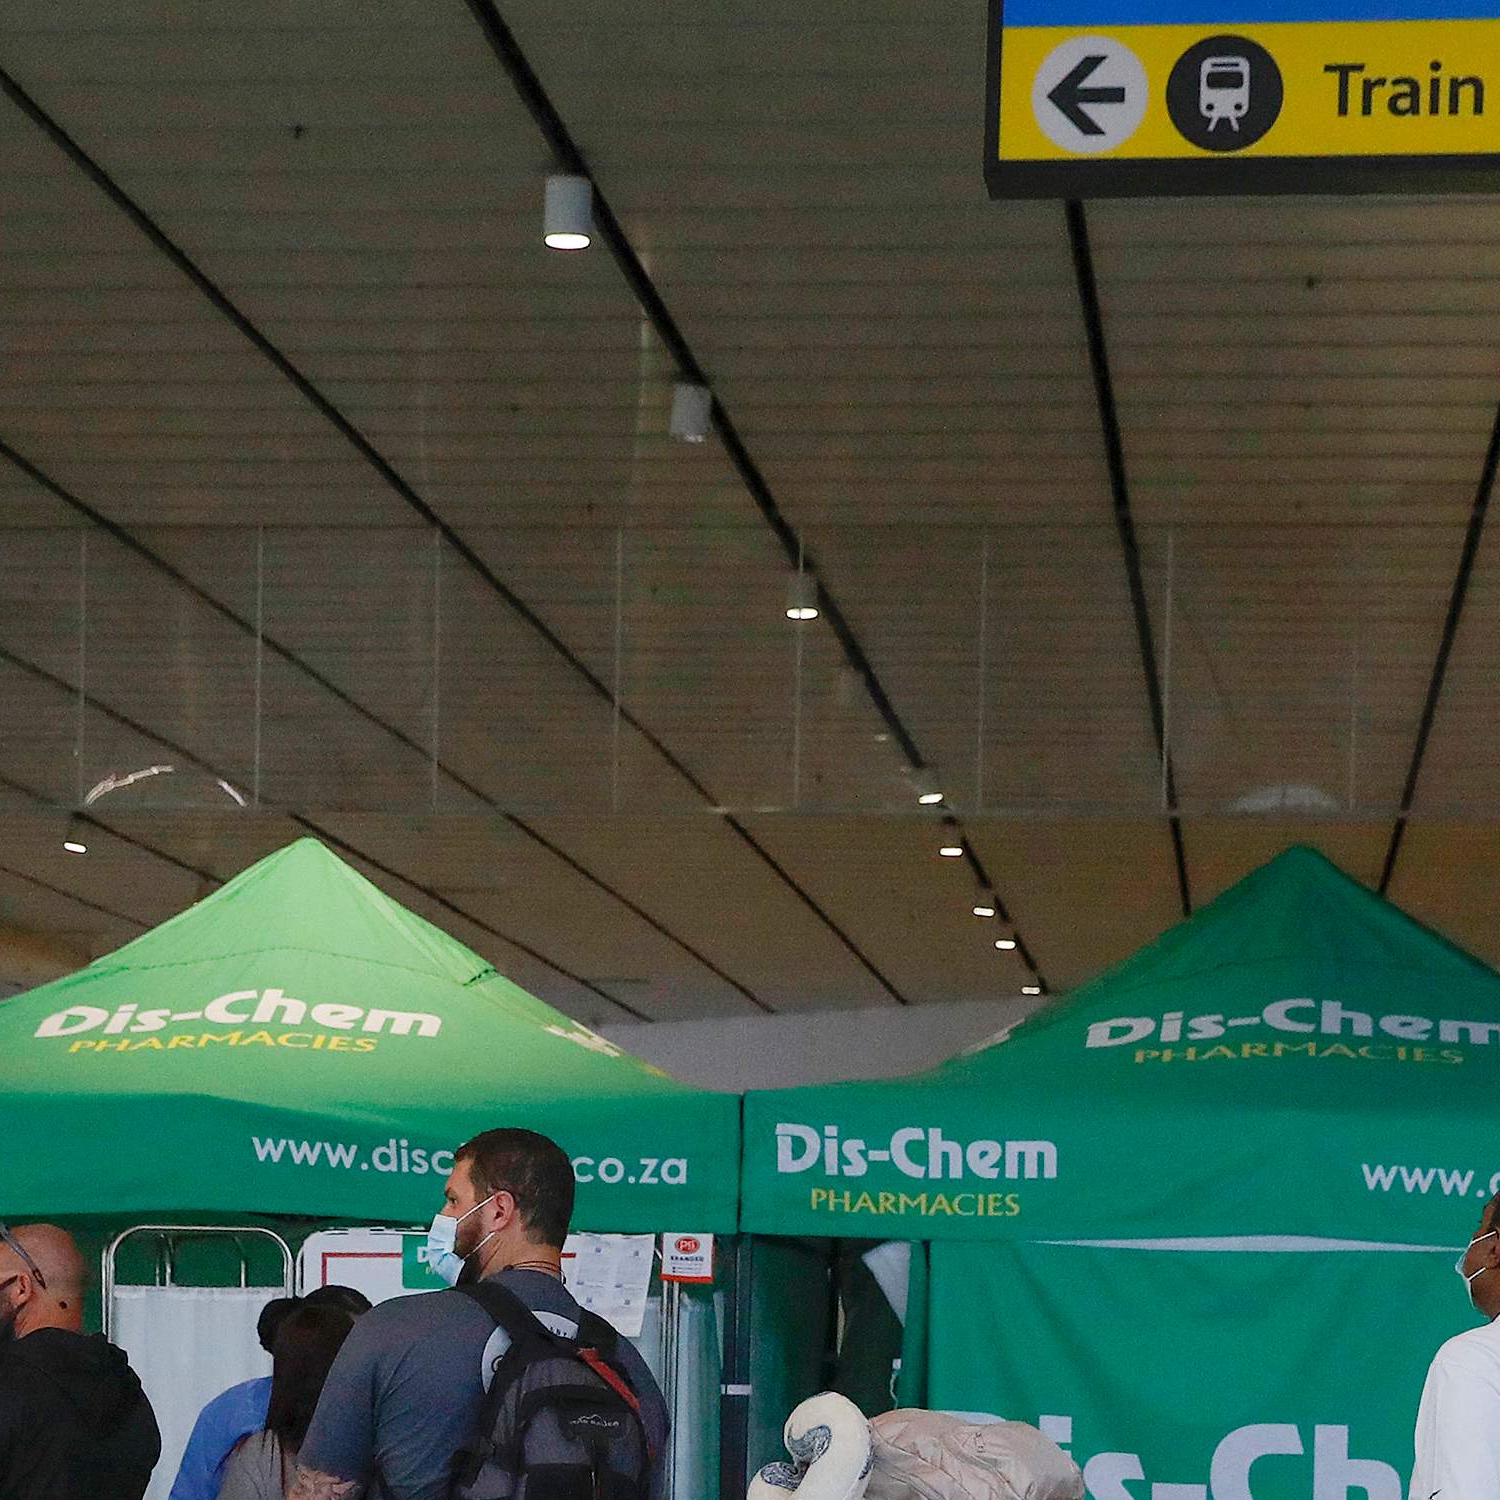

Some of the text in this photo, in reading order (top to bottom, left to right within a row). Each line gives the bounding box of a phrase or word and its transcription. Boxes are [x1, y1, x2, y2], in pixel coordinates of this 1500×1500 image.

[1323, 60, 1485, 118] Train
[34, 988, 442, 1038] Dis-Chem
[68, 1031, 378, 1053] PHARMACIES
[1134, 1041, 1464, 1064] PHARMACIES
[252, 1136, 688, 1185] www.discco.za
[775, 1123, 1057, 1179] Dis-Chem
[811, 1188, 1020, 1216] PHARMACIES
